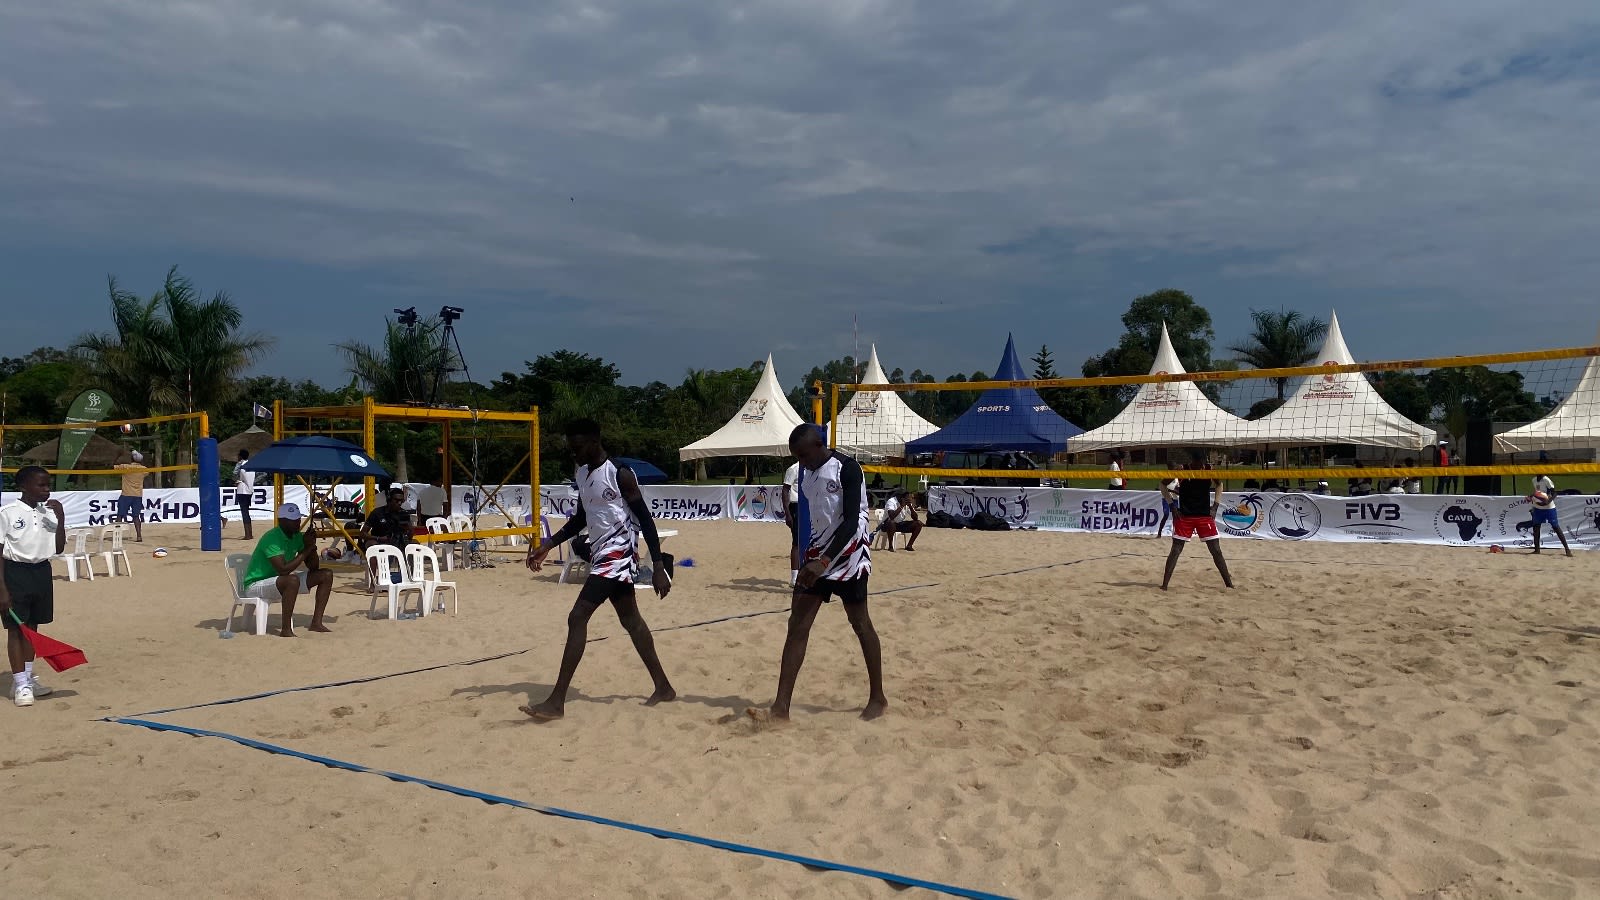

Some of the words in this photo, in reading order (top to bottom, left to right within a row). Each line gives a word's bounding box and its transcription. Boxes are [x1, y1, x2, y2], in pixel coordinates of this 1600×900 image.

[222, 488, 267, 506] FIB
[651, 498, 698, 510] S-TEAM
[89, 498, 161, 512] S-TM
[163, 502, 200, 519] HD
[698, 503, 722, 516] HD
[1081, 500, 1131, 515] S-TEAM
[1345, 503, 1401, 521] FIVB
[1081, 516, 1130, 530] MEDIA
[1131, 508, 1159, 527] HD
[1252, 510, 1265, 532] BEACH
[1447, 514, 1473, 522] CAVB
